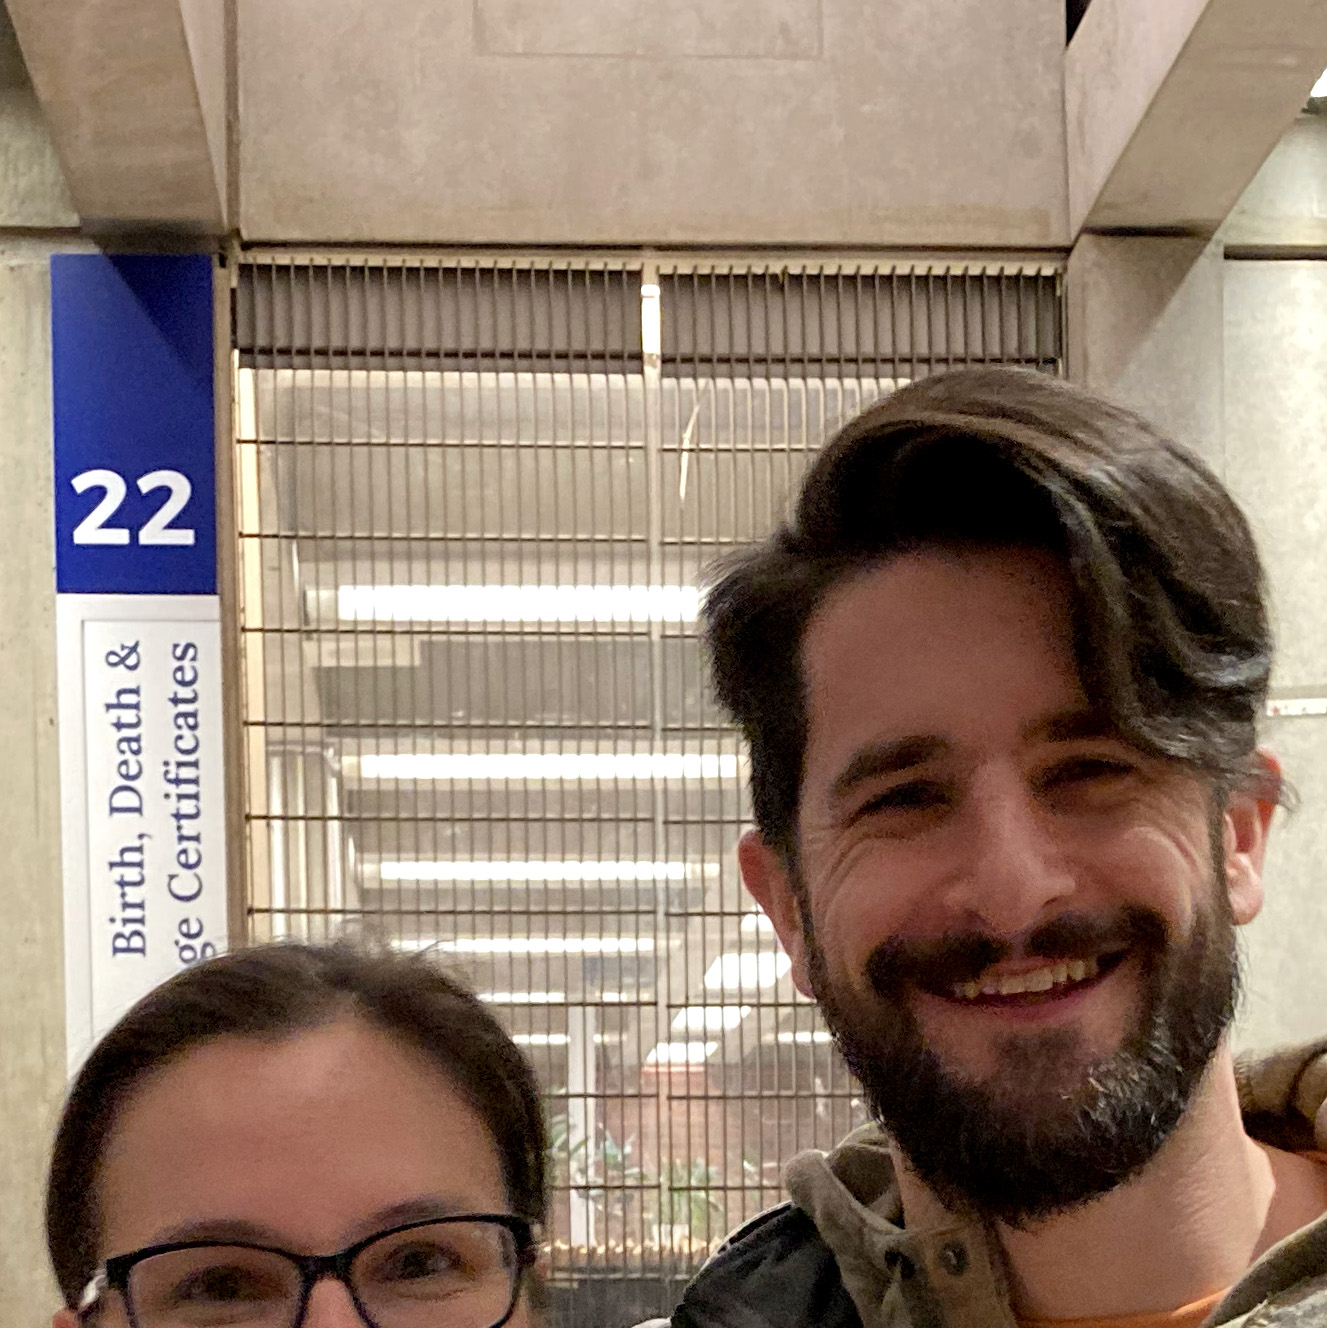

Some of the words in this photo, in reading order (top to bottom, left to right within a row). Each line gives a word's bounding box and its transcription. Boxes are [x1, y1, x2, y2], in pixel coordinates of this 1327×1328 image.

[71, 468, 196, 546] 22
[105, 640, 141, 672] &
[105, 685, 144, 817] Death
[163, 641, 204, 903] Certificates
[109, 832, 152, 957] Birth,
